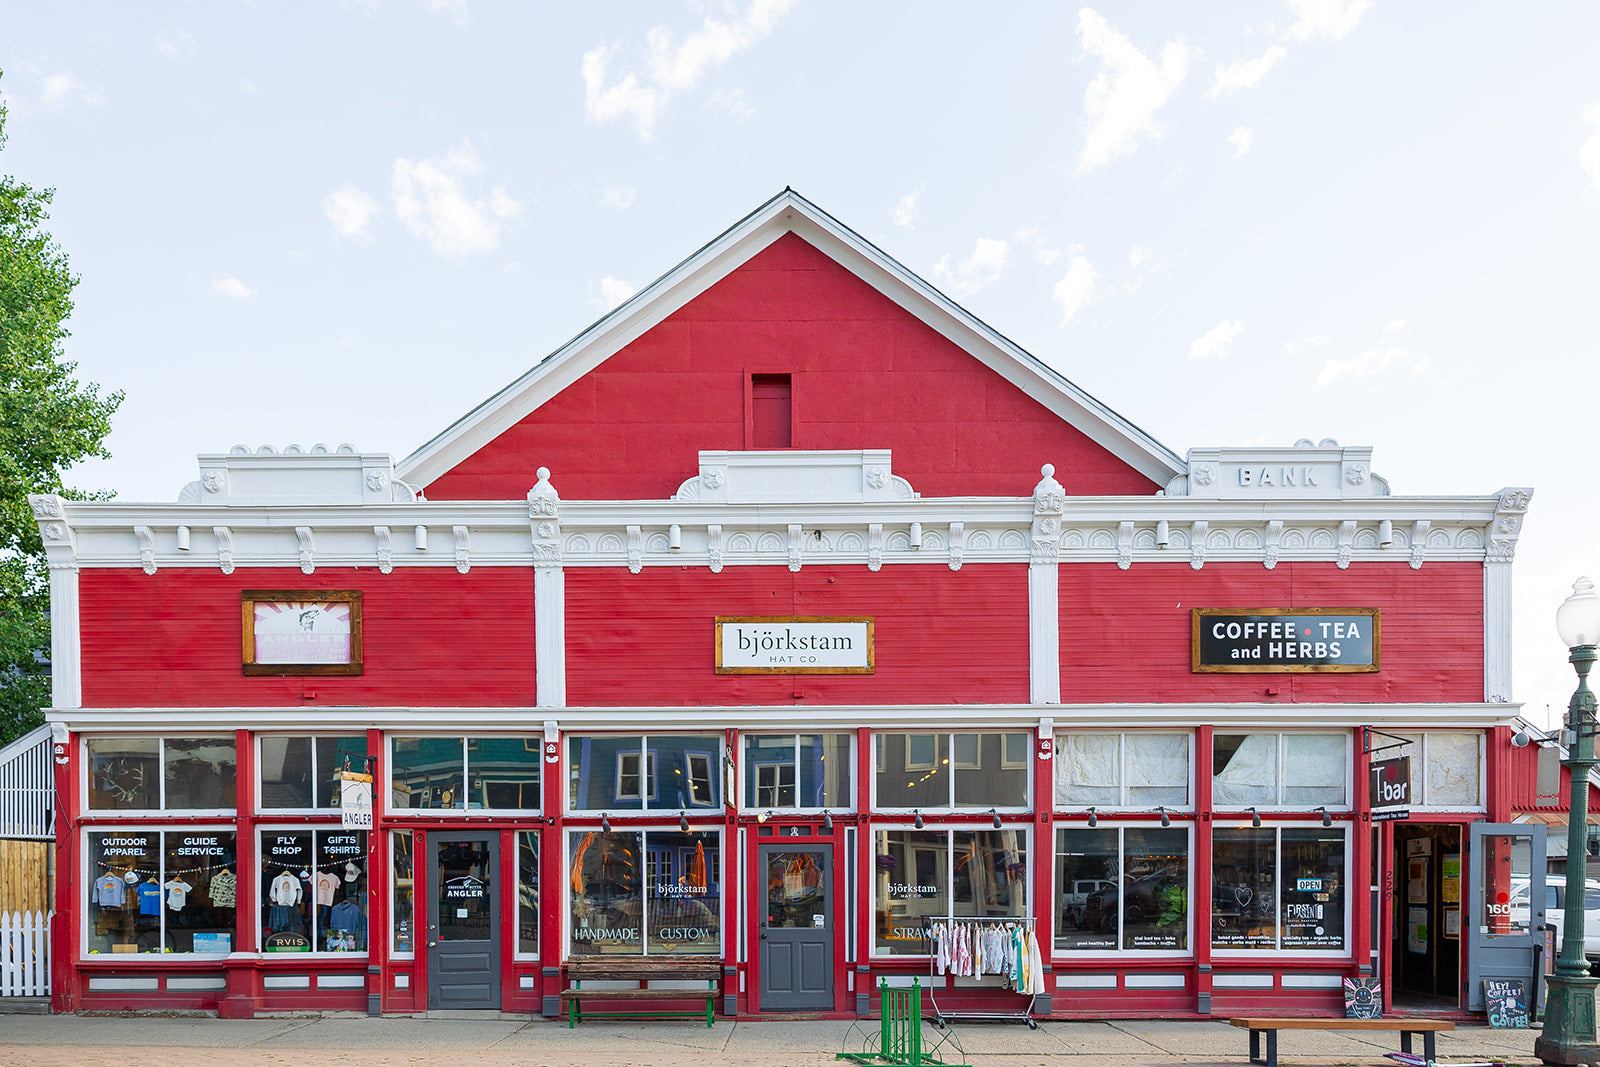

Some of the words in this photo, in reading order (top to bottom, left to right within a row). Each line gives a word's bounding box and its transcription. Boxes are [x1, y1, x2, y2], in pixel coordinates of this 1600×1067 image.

[1238, 467, 1318, 486] BANK
[1212, 623, 1296, 639] COFFEE
[1319, 623, 1360, 638] TEA
[262, 634, 346, 642] ANGLER
[737, 629, 853, 657] björkstam
[1231, 646, 1260, 658] and
[1269, 642, 1342, 658] HERBS
[344, 813, 371, 825] ANGLER
[102, 838, 147, 846] OUTDOOR
[184, 837, 217, 845] GUIDE
[328, 836, 356, 844] GIFTS
[103, 848, 146, 856] APPAREL
[178, 847, 224, 855] SERVICE
[323, 846, 360, 854] T-SHIRTS
[658, 884, 707, 896] björkstam
[887, 883, 936, 895] björkstam
[1300, 881, 1320, 889] OPEN
[575, 928, 639, 940] HANDMADE
[660, 928, 710, 939] CUSTOM
[1490, 981, 1509, 990] HEY!
[1487, 989, 1521, 997] COFFEE!
[1491, 1014, 1528, 1027] COFFEE!
